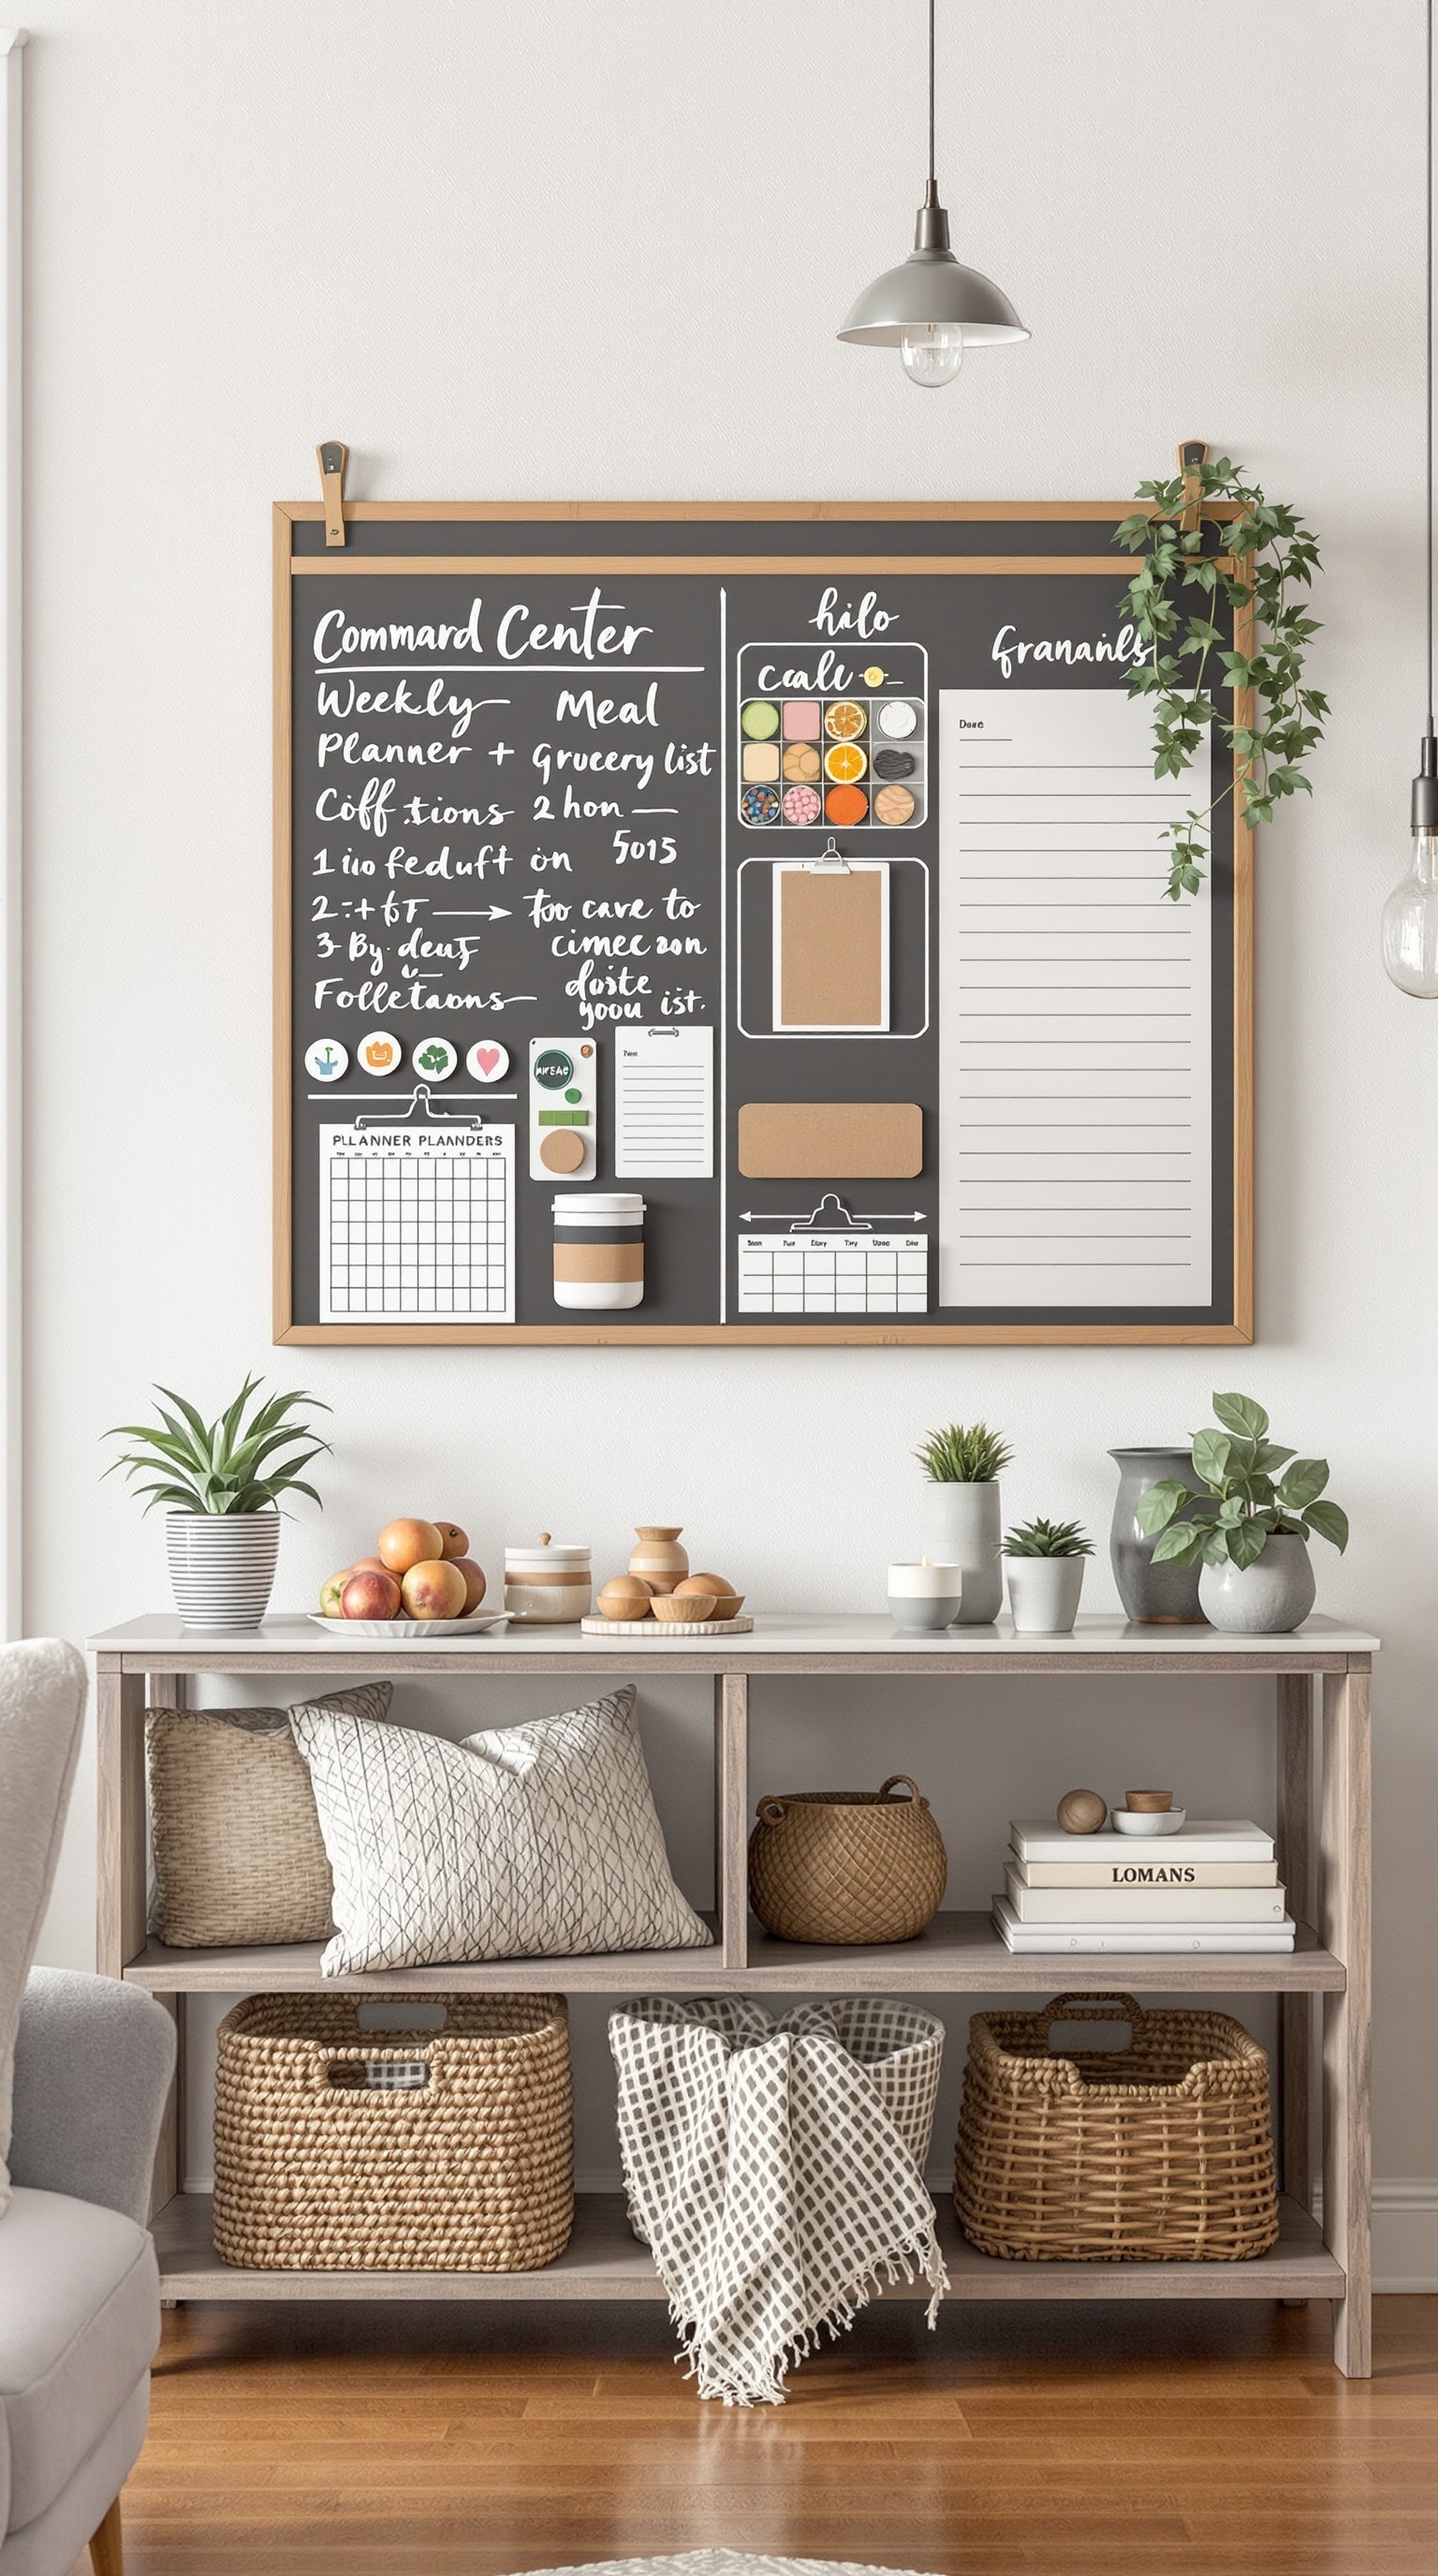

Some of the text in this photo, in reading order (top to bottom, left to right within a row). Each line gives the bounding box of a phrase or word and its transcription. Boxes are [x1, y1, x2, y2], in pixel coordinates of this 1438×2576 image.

[496, 586, 654, 661] Center
[317, 678, 511, 738] Weekly
[555, 681, 660, 730] Meal
[317, 731, 473, 768] Planner
[664, 741, 717, 776] list
[533, 795, 555, 821] 2
[661, 887, 702, 920] to
[1111, 1866, 1196, 1883] LOMANS
